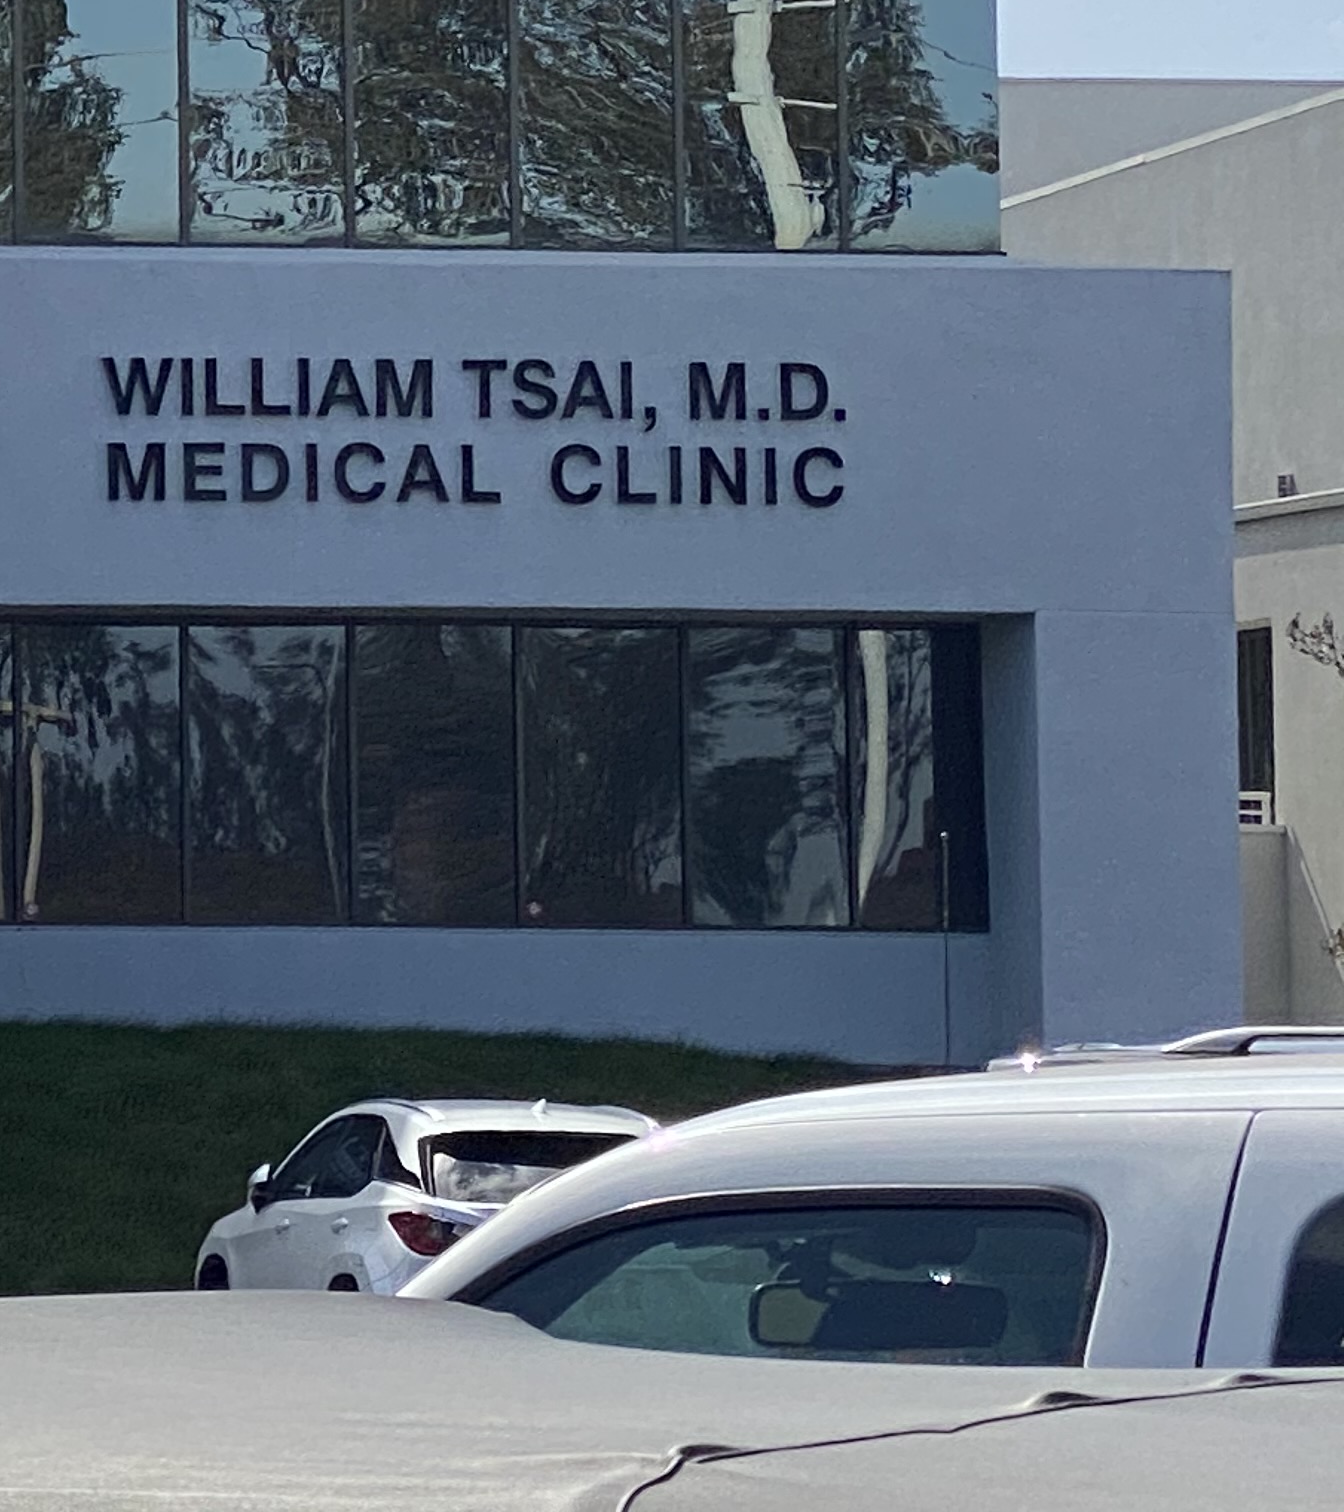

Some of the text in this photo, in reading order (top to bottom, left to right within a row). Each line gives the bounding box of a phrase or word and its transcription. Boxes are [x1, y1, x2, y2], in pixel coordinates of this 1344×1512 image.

[101, 357, 848, 432] WILLIAM TSAI, M.D.
[107, 442, 846, 508] MEDICAL CLINIC
